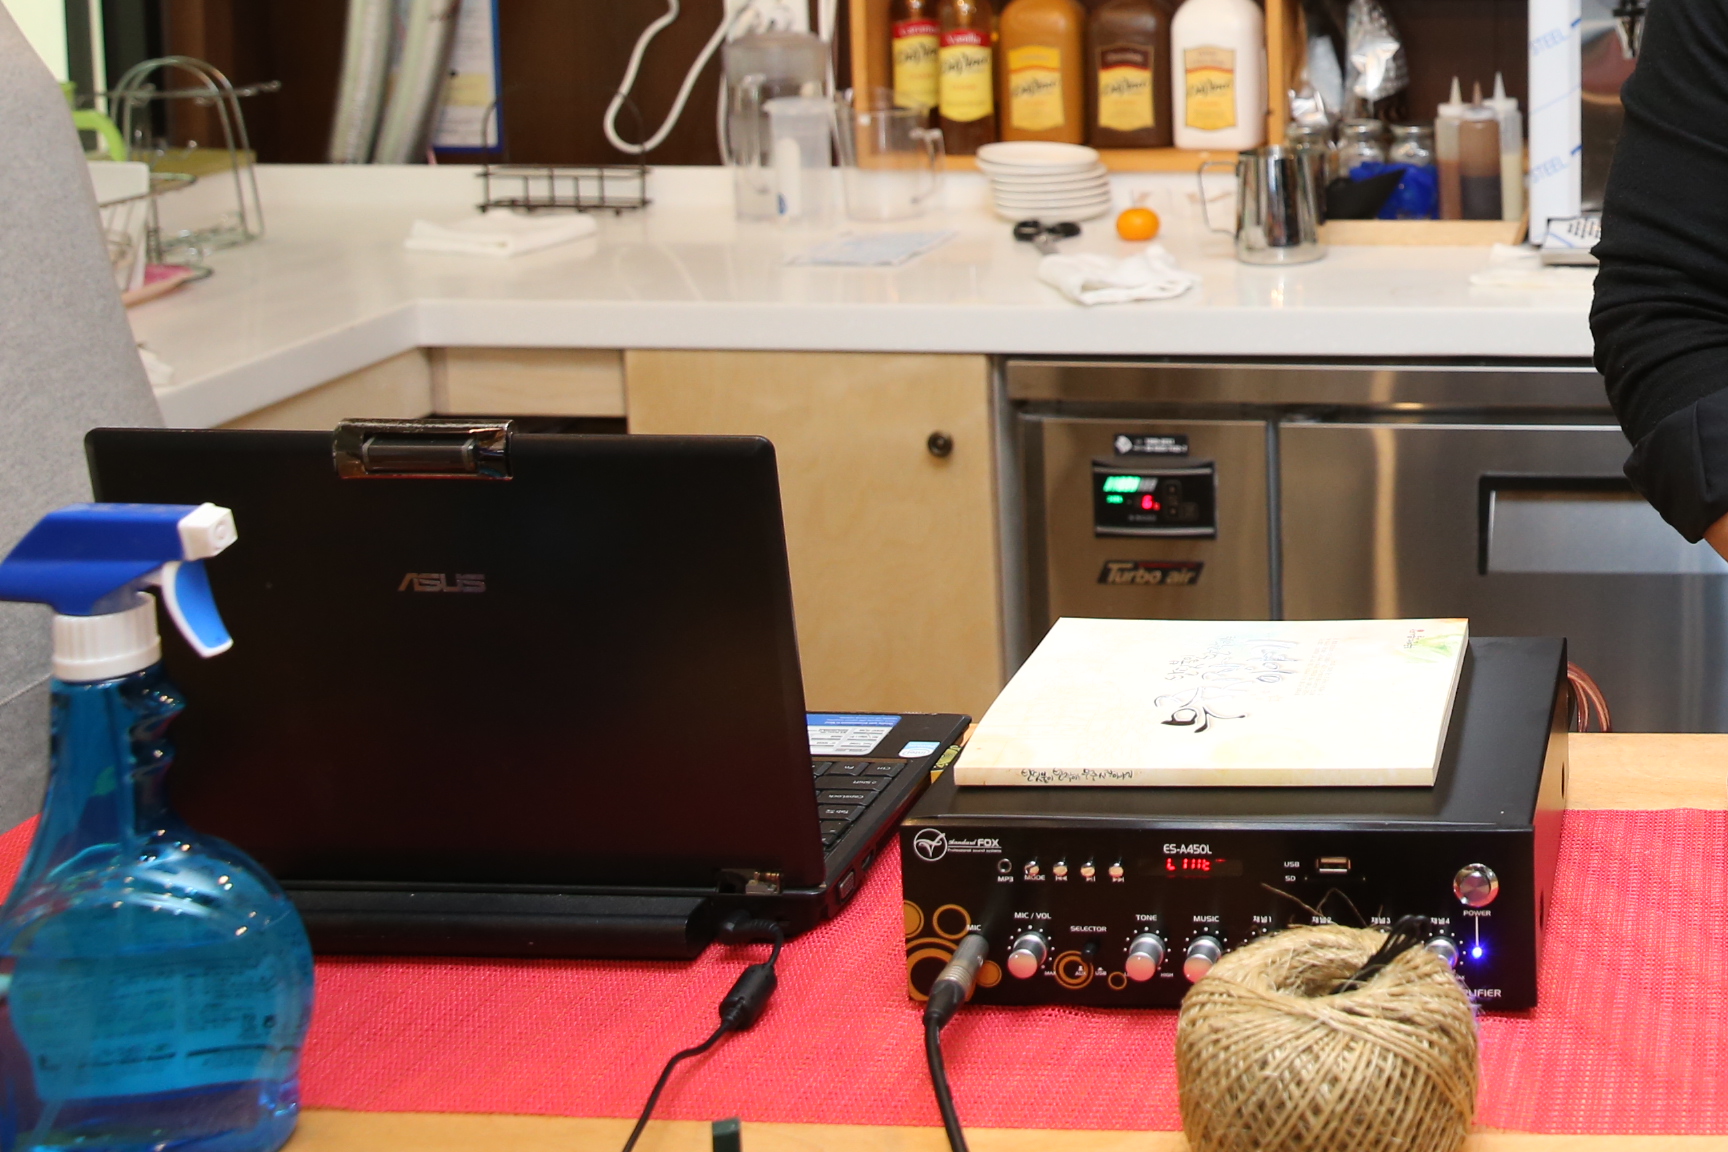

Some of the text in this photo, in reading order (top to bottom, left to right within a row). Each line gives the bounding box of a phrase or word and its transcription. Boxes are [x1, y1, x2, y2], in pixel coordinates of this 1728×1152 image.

[1107, 561, 1197, 585] Turbo air
[398, 572, 487, 593] ASUS
[977, 838, 1000, 847] FOX
[1163, 843, 1213, 855] ES-A450L
[1193, 915, 1220, 923] MUSIC
[1070, 925, 1107, 933] SELECTOR
